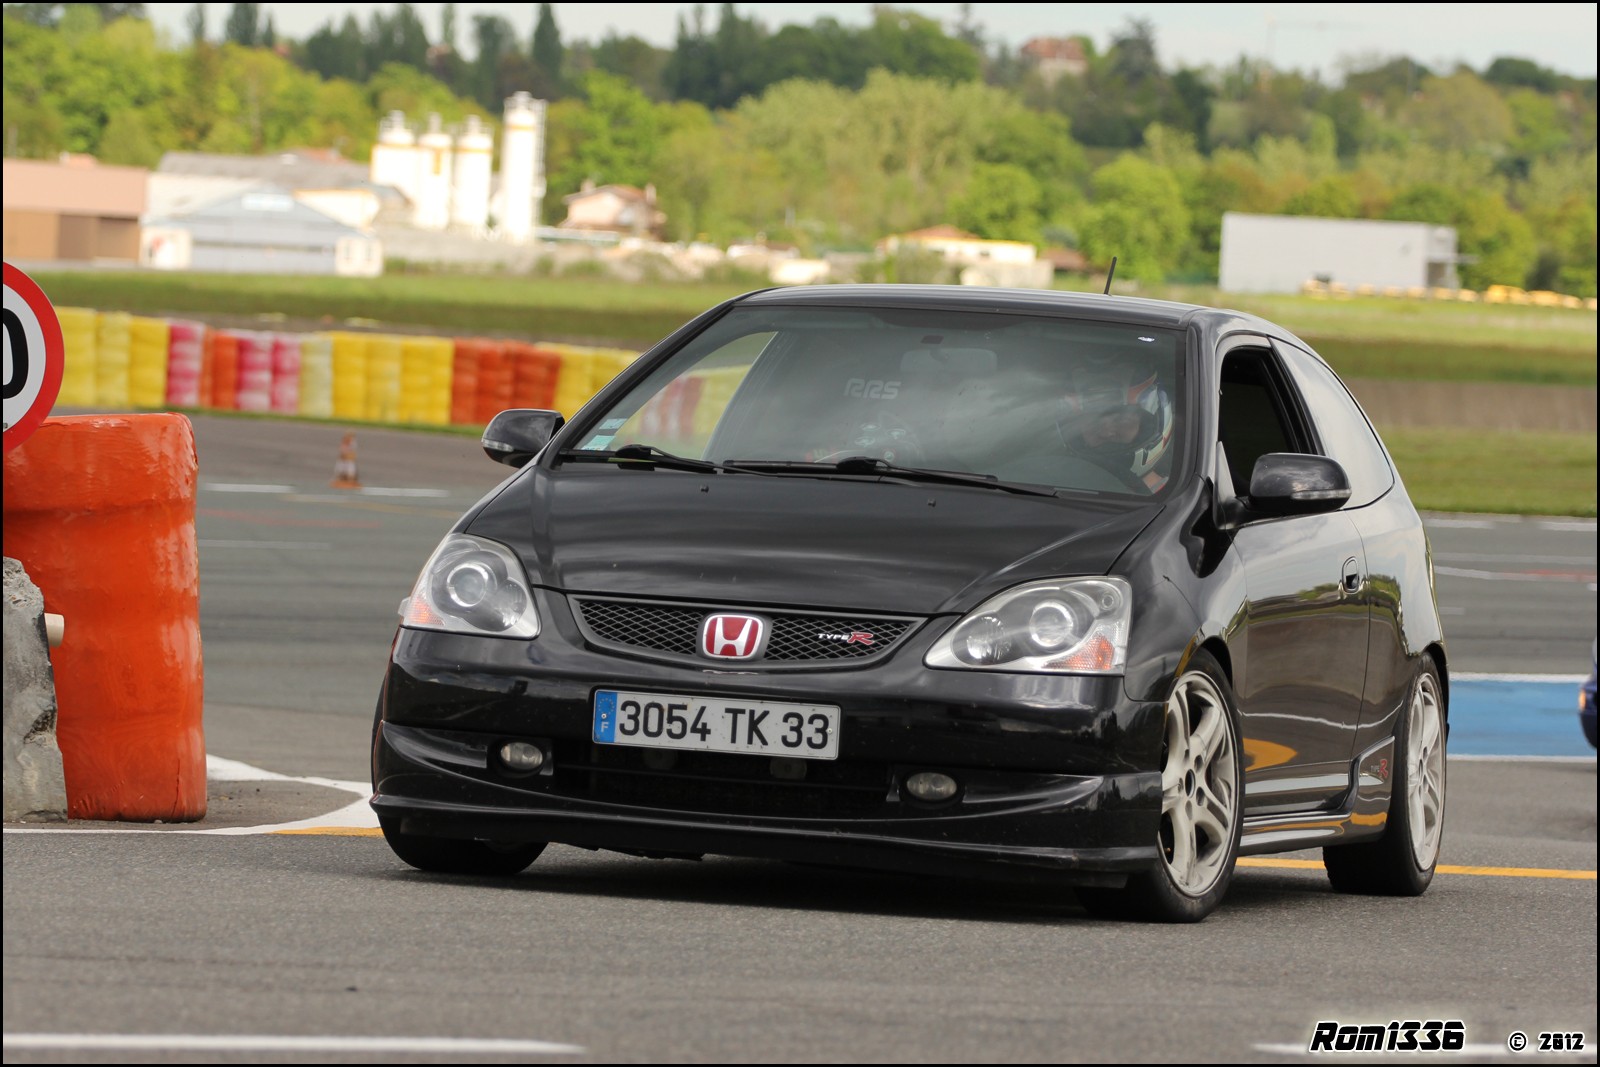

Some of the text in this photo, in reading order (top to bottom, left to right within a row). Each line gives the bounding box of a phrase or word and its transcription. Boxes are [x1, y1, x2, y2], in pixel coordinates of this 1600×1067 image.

[843, 378, 902, 400] RRS
[847, 631, 876, 646] R
[600, 722, 609, 733] F
[618, 700, 830, 750] 3054 TK 33
